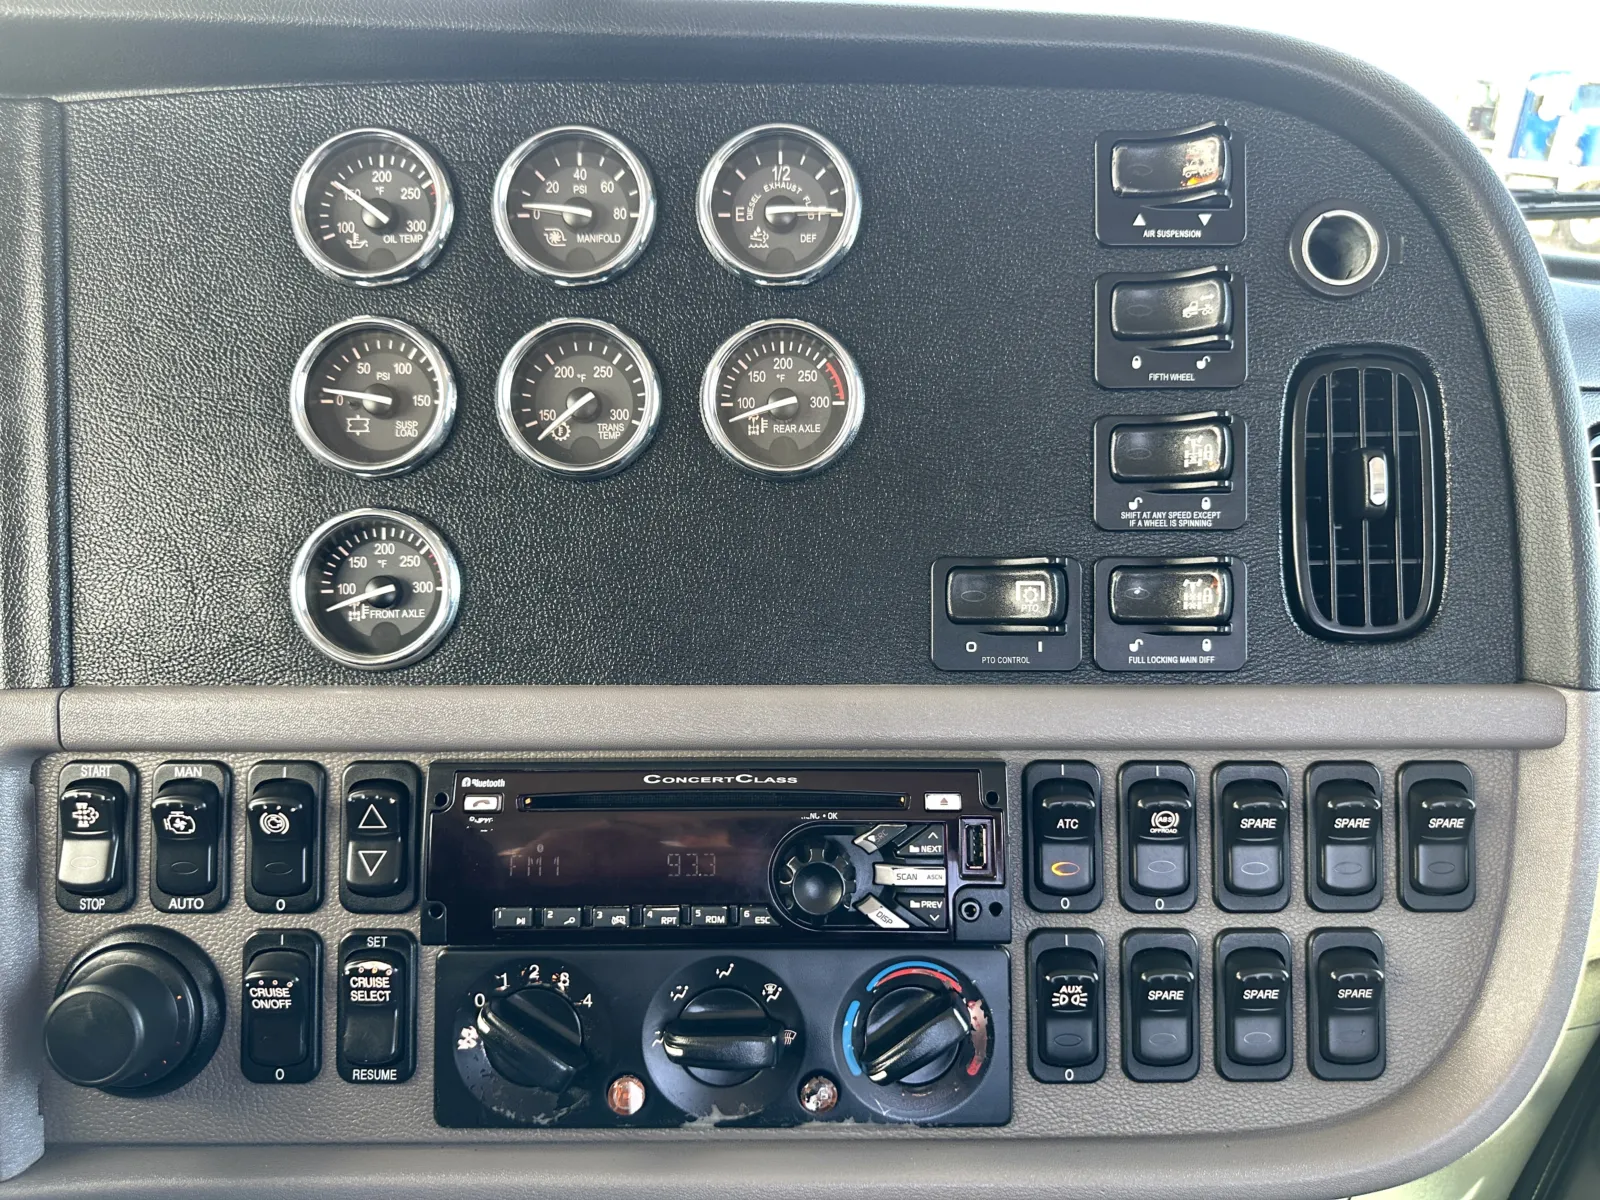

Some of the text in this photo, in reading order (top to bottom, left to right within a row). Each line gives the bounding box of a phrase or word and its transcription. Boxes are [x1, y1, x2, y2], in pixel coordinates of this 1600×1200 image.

[372, 171, 392, 182] 200
[573, 169, 587, 180] 40
[772, 166, 790, 181] 1/2
[546, 182, 559, 193] 20
[573, 186, 587, 194] PSI
[601, 182, 614, 193] 60
[401, 189, 420, 200] 250
[747, 194, 761, 220] DIESEL
[764, 182, 802, 194] EXHAUST
[533, 208, 540, 220] 0
[613, 208, 627, 220] 80
[736, 207, 745, 221] E
[337, 222, 354, 233] 100
[406, 221, 426, 232] 300
[383, 234, 424, 244] OIL TEMP
[577, 234, 621, 243] MANIFOLD
[800, 234, 817, 243] DEF
[1143, 230, 1201, 238] AIR SUSPENSION
[357, 362, 371, 374] 50
[393, 363, 412, 375] 100
[773, 358, 793, 369] 200
[554, 366, 574, 378] 200
[593, 366, 613, 378] 250
[748, 371, 766, 382] 150
[798, 370, 818, 382] 250
[337, 394, 344, 406] 0
[412, 395, 431, 406] 150
[738, 397, 755, 408] 100
[810, 396, 829, 408] 300
[539, 410, 556, 420] 150
[610, 409, 629, 420] 300
[395, 429, 418, 437] LOAD
[597, 423, 624, 432] TRANS
[773, 424, 821, 433] REAR AXLE
[374, 543, 395, 555] 200
[348, 556, 367, 568] 150
[399, 555, 420, 567] 250
[338, 583, 356, 595] 100
[412, 581, 433, 593] 300
[370, 609, 425, 618] FRONT AXLE
[81, 766, 112, 776] START
[174, 767, 202, 777] MAN
[472, 779, 505, 787] Bluetooth
[1057, 819, 1079, 829] ATC
[1240, 818, 1277, 829] SPARE
[1334, 818, 1371, 829] SPARE
[1428, 818, 1465, 828] SPARE
[79, 899, 105, 910] STOP
[168, 898, 204, 909] AUTO
[661, 916, 677, 925] RPT
[876, 911, 894, 924] DISP
[366, 936, 387, 947] SET
[529, 964, 539, 979] 2
[350, 977, 390, 988] CRUISE
[500, 972, 508, 986] 1
[250, 988, 290, 998] CRUISE
[350, 990, 391, 1001] SELECT
[1148, 991, 1184, 1000] SPARE
[1243, 990, 1279, 999] SPARE
[1337, 989, 1373, 998] SPARE
[252, 999, 292, 1009] ON/OFF
[475, 993, 485, 1007] 0
[583, 994, 593, 1007] 4
[352, 1069, 397, 1080] RESUME
